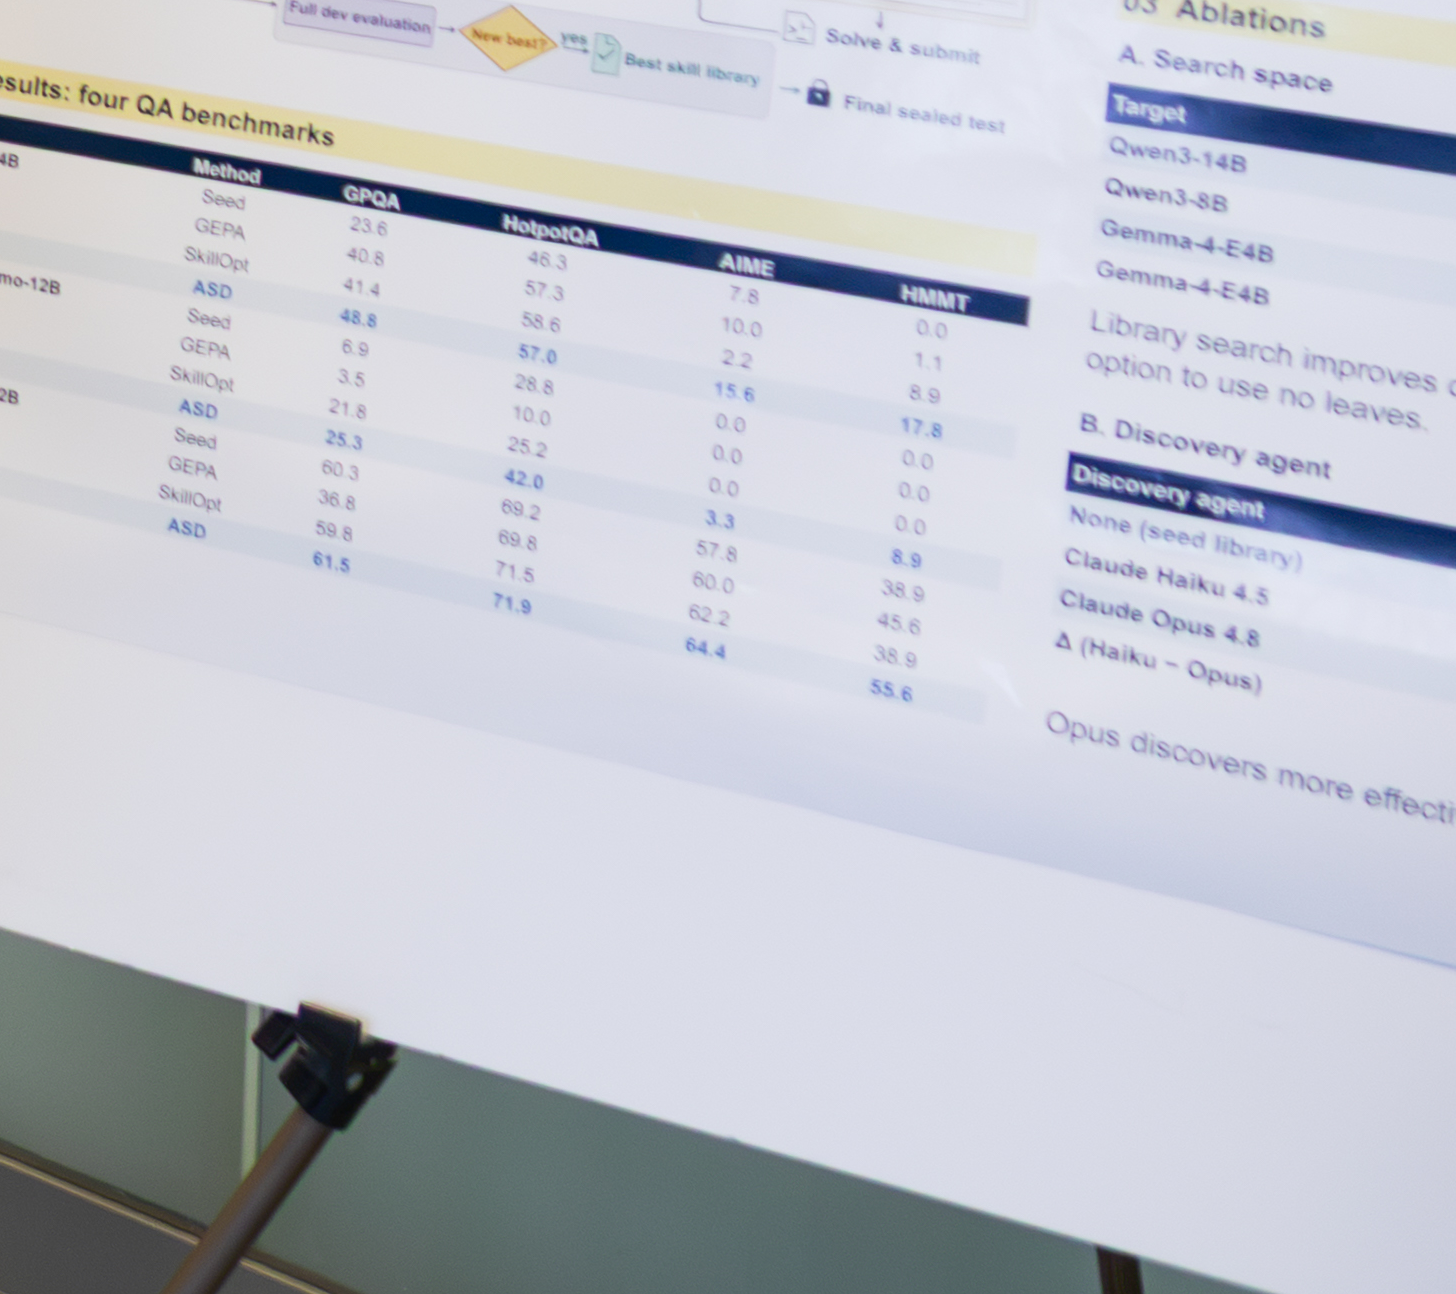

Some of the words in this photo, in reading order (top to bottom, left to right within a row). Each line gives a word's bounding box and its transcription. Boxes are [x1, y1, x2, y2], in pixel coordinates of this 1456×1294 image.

[1118, 45, 1145, 65] A.
[1154, 48, 1245, 82] Search
[1253, 64, 1333, 94] space
[79, 83, 129, 113] four
[136, 94, 174, 122] QA
[182, 101, 335, 148] benchmarks
[1112, 93, 1187, 125] Target
[1109, 135, 1248, 174] Qwen3-14B
[1104, 176, 1230, 214] Qwen3-8B
[193, 157, 262, 186] Method
[343, 184, 401, 212] GPQA
[502, 212, 600, 249] HotpotQA
[718, 252, 776, 279] AIME
[901, 283, 970, 314] HMMT
[1100, 218, 1276, 264] Gemma-4-E4B
[1095, 259, 1271, 306] Gemma-4-E4B
[1091, 309, 1187, 351] Library
[1195, 329, 1294, 368] search
[1303, 348, 1438, 397] improves
[1085, 349, 1173, 386] option
[1182, 365, 1209, 390] to
[1218, 374, 1270, 403] use
[1278, 387, 1316, 411] no
[1325, 390, 1430, 433] leaves.
[1080, 412, 1105, 435] B.
[1114, 419, 1248, 466] Discovery
[1255, 440, 1332, 481] agent
[1071, 462, 1191, 511] Discovery
[1195, 488, 1267, 523] agent
[1064, 547, 1148, 582] Claude
[1156, 566, 1225, 599] Haiku
[1232, 583, 1270, 607] 4.5
[1060, 588, 1144, 624] Claude
[1151, 608, 1216, 642] Opus
[1223, 624, 1261, 649] 4.8
[1045, 710, 1121, 748] Opus
[1130, 730, 1269, 783] discovers
[1278, 766, 1355, 803] more
[1363, 786, 1456, 825] effecti
